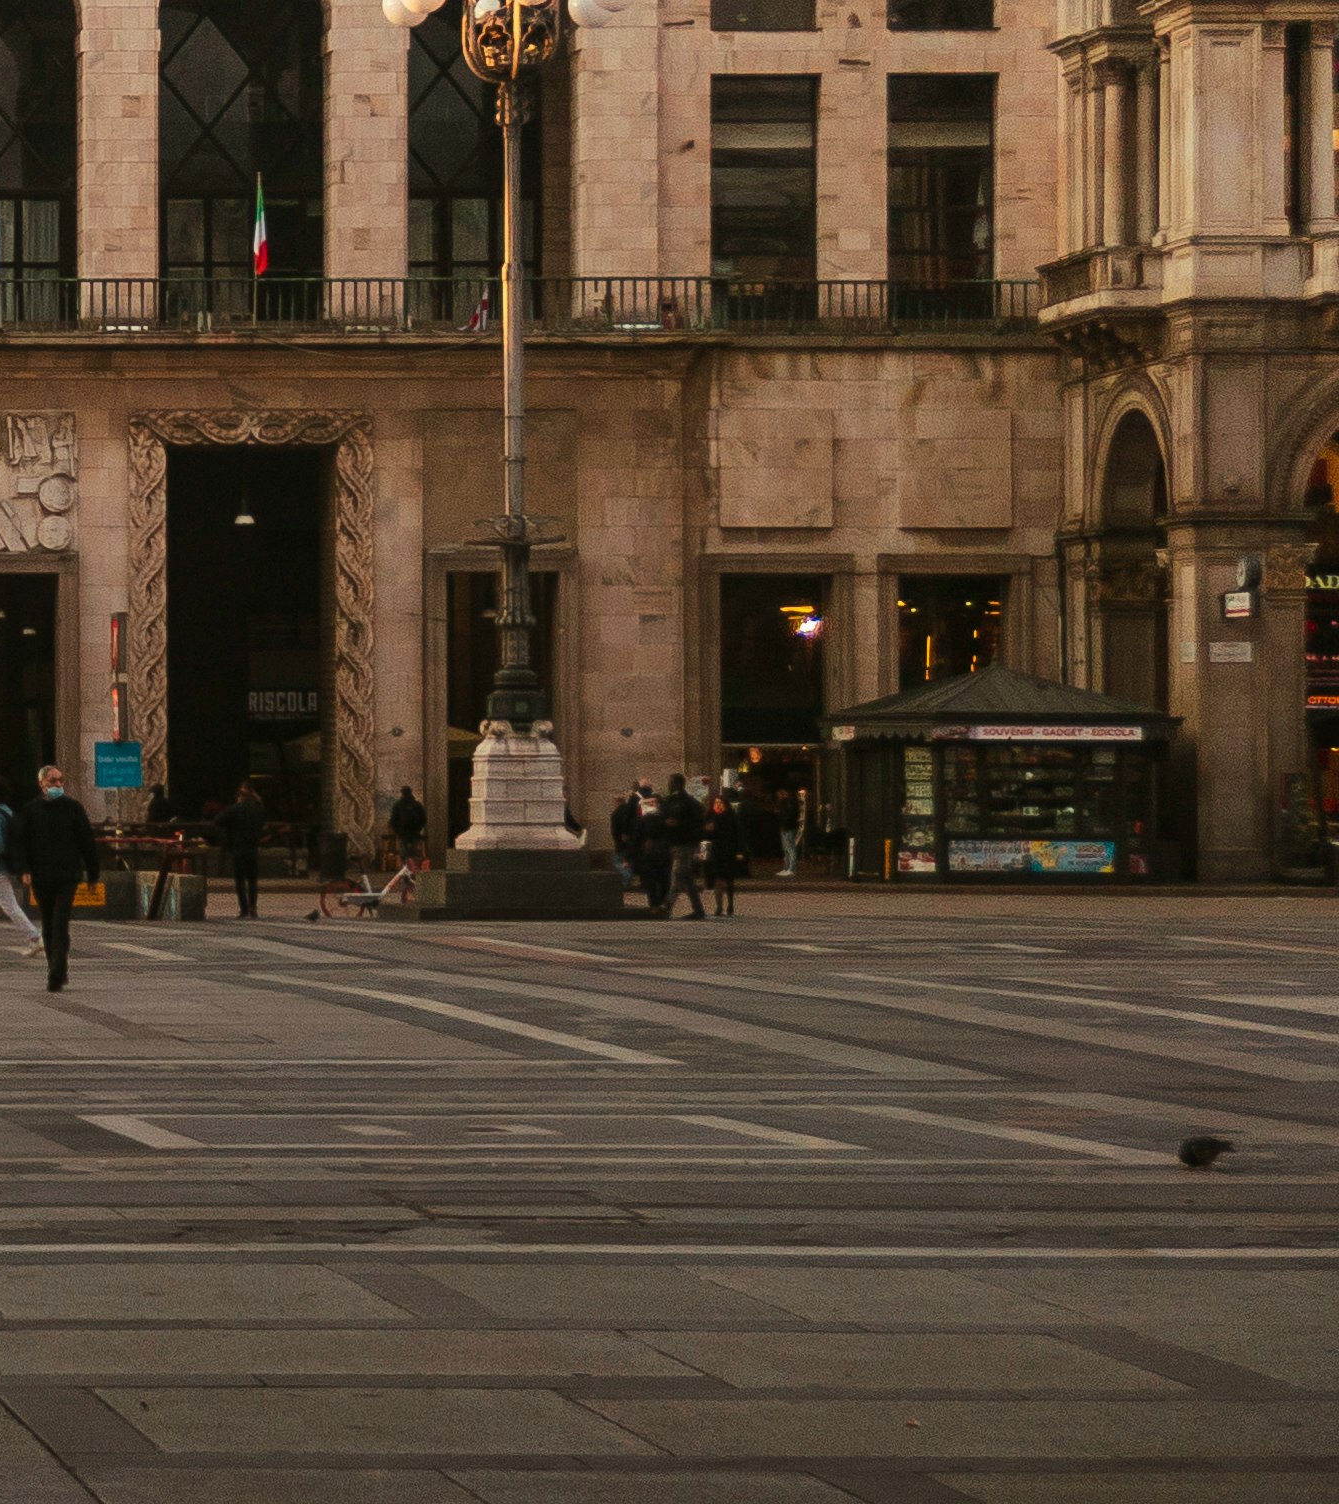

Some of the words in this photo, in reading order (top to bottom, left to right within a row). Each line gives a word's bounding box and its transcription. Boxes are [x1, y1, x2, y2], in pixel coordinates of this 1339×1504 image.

[982, 727, 1034, 737] SOUVENIR
[1042, 727, 1084, 737] GADGET
[1092, 727, 1135, 737] EDICOLA
